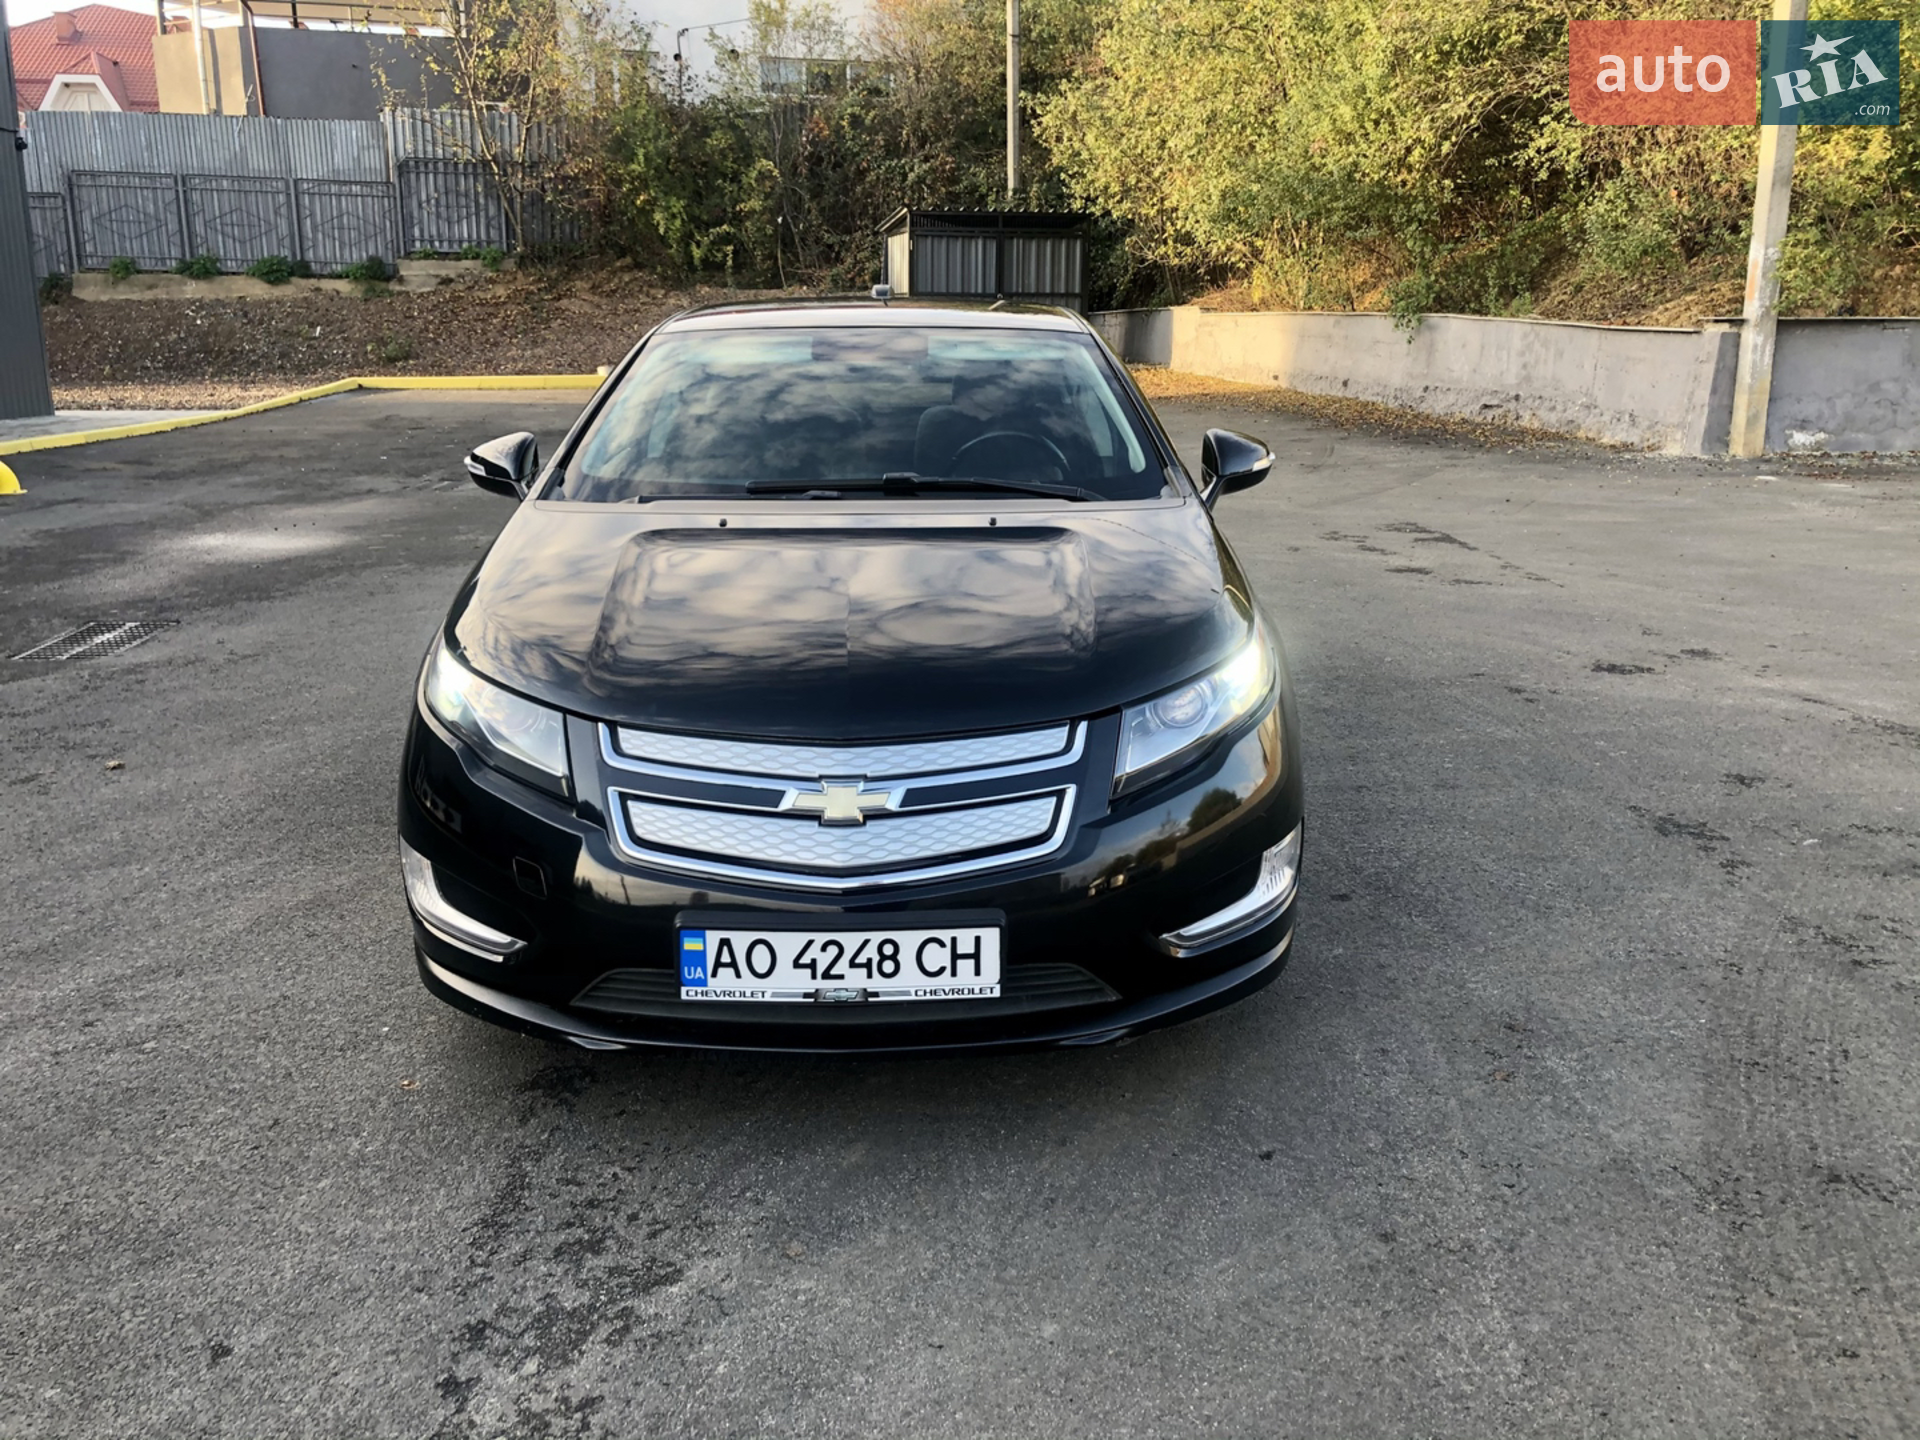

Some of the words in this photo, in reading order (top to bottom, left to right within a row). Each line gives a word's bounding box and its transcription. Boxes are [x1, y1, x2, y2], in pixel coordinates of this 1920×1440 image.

[710, 937, 777, 979] AO
[792, 938, 901, 980] 4248
[915, 935, 981, 978] CH
[684, 966, 705, 980] UA
[685, 989, 768, 999] CHEVROLET
[914, 986, 996, 997] CHEVROLET
